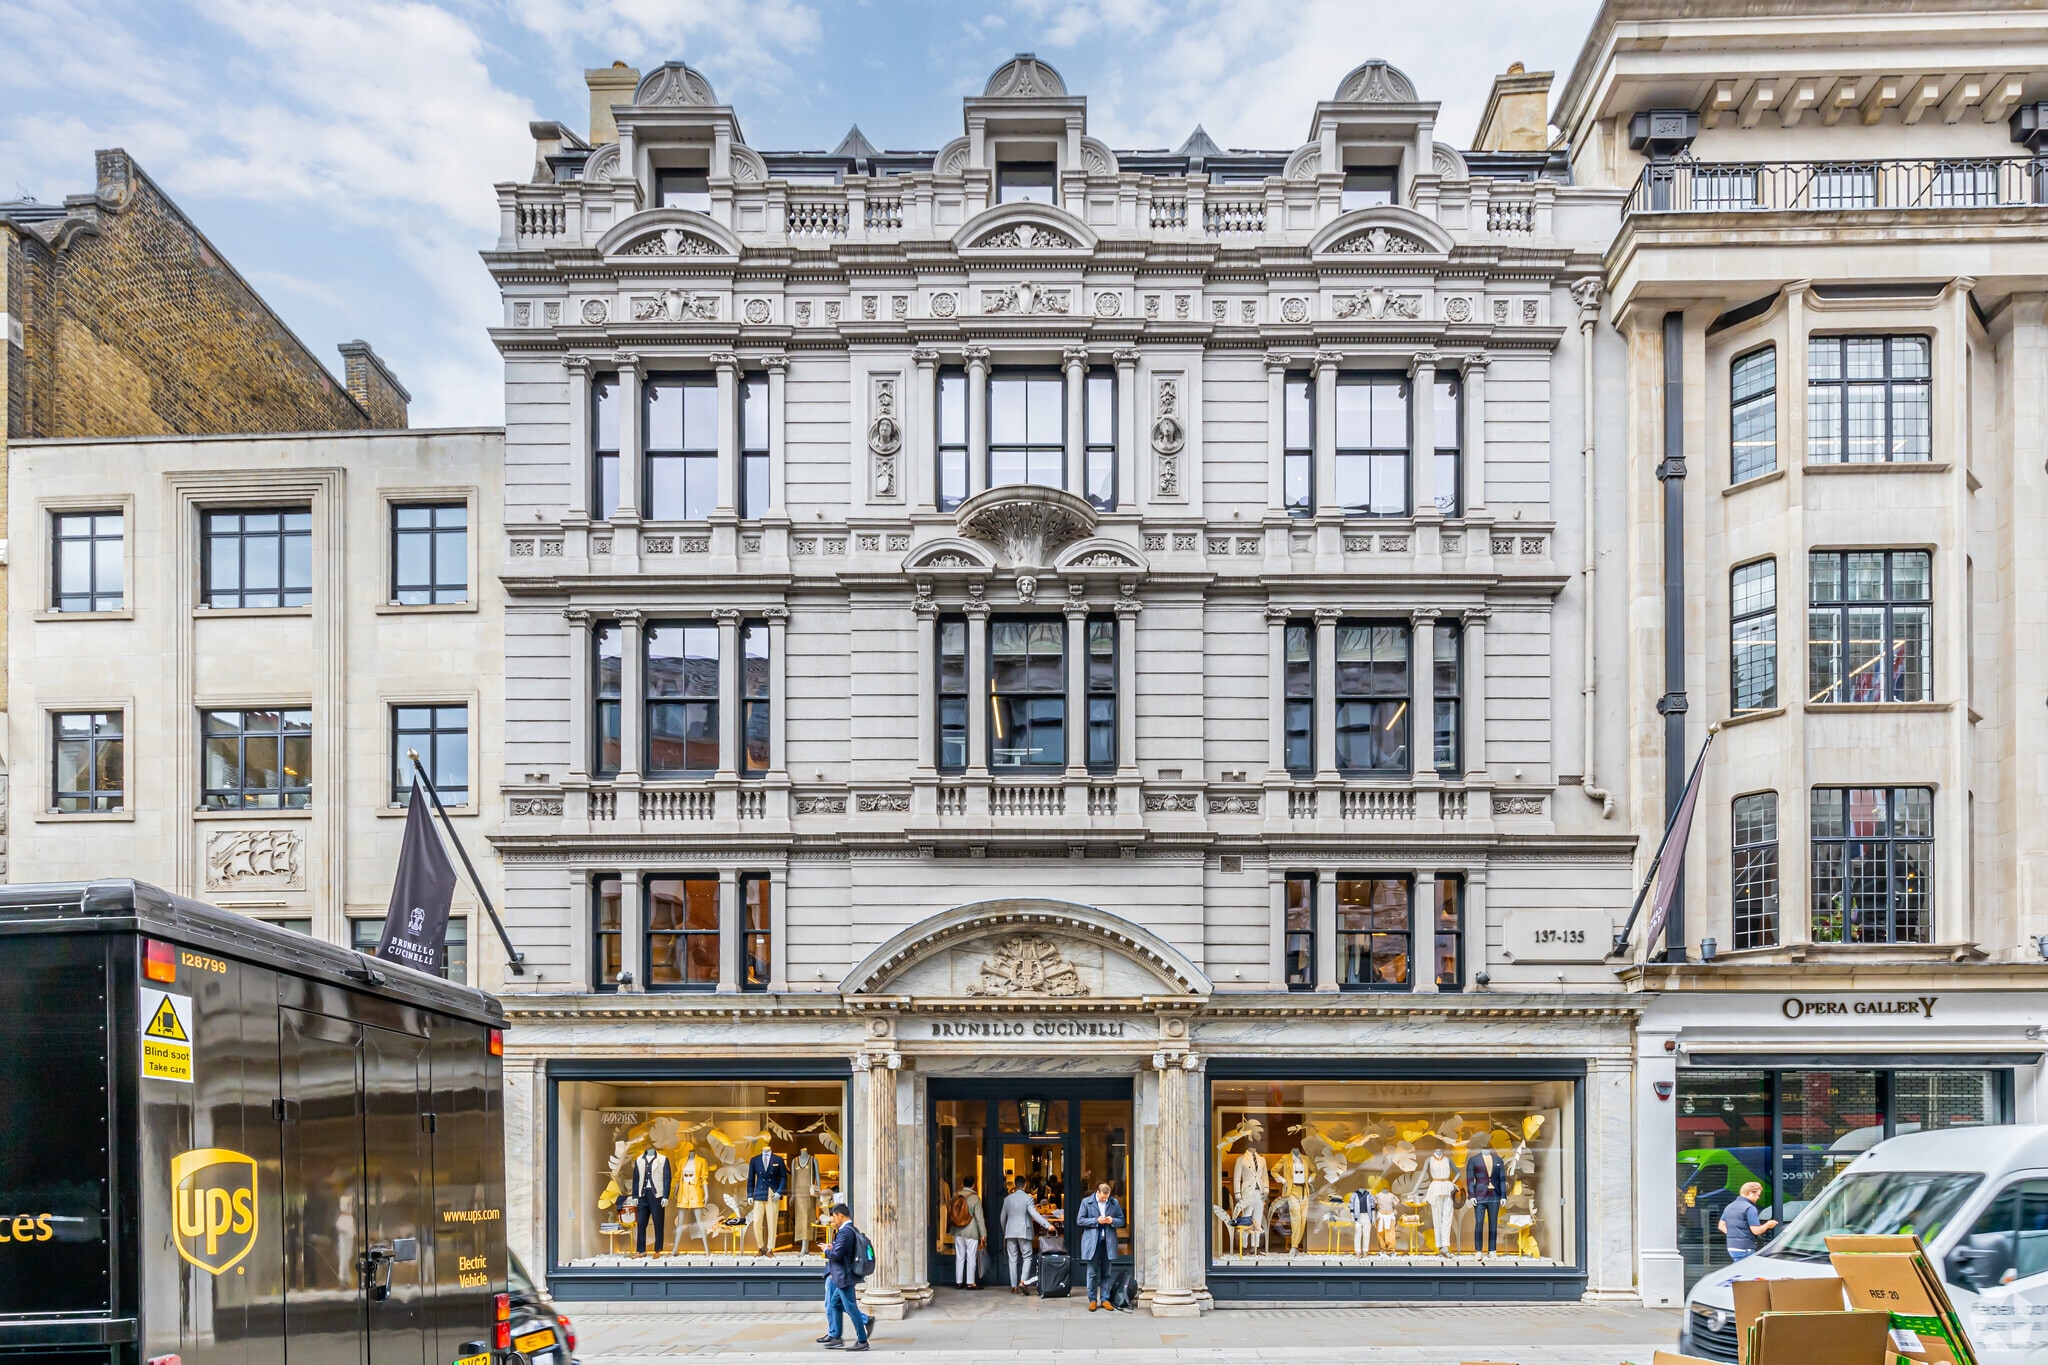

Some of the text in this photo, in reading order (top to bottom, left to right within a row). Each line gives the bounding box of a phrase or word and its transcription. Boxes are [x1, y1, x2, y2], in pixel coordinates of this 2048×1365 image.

[1535, 930, 1585, 943] 137-135
[391, 936, 435, 956] BRUNELLO
[388, 945, 433, 965] CUCINELLI
[1782, 998, 1939, 1019] OPERA GALLERY
[932, 1023, 1125, 1036] BRUNELLO CUCINELLI
[145, 1046, 190, 1062] Blind spot
[149, 1061, 187, 1075] Take care
[1827, 1088, 1839, 1096] 134
[178, 1187, 254, 1256] ups
[443, 1209, 500, 1224] www.ups.com
[459, 1254, 487, 1271] Electric
[459, 1271, 488, 1289] Vehicle
